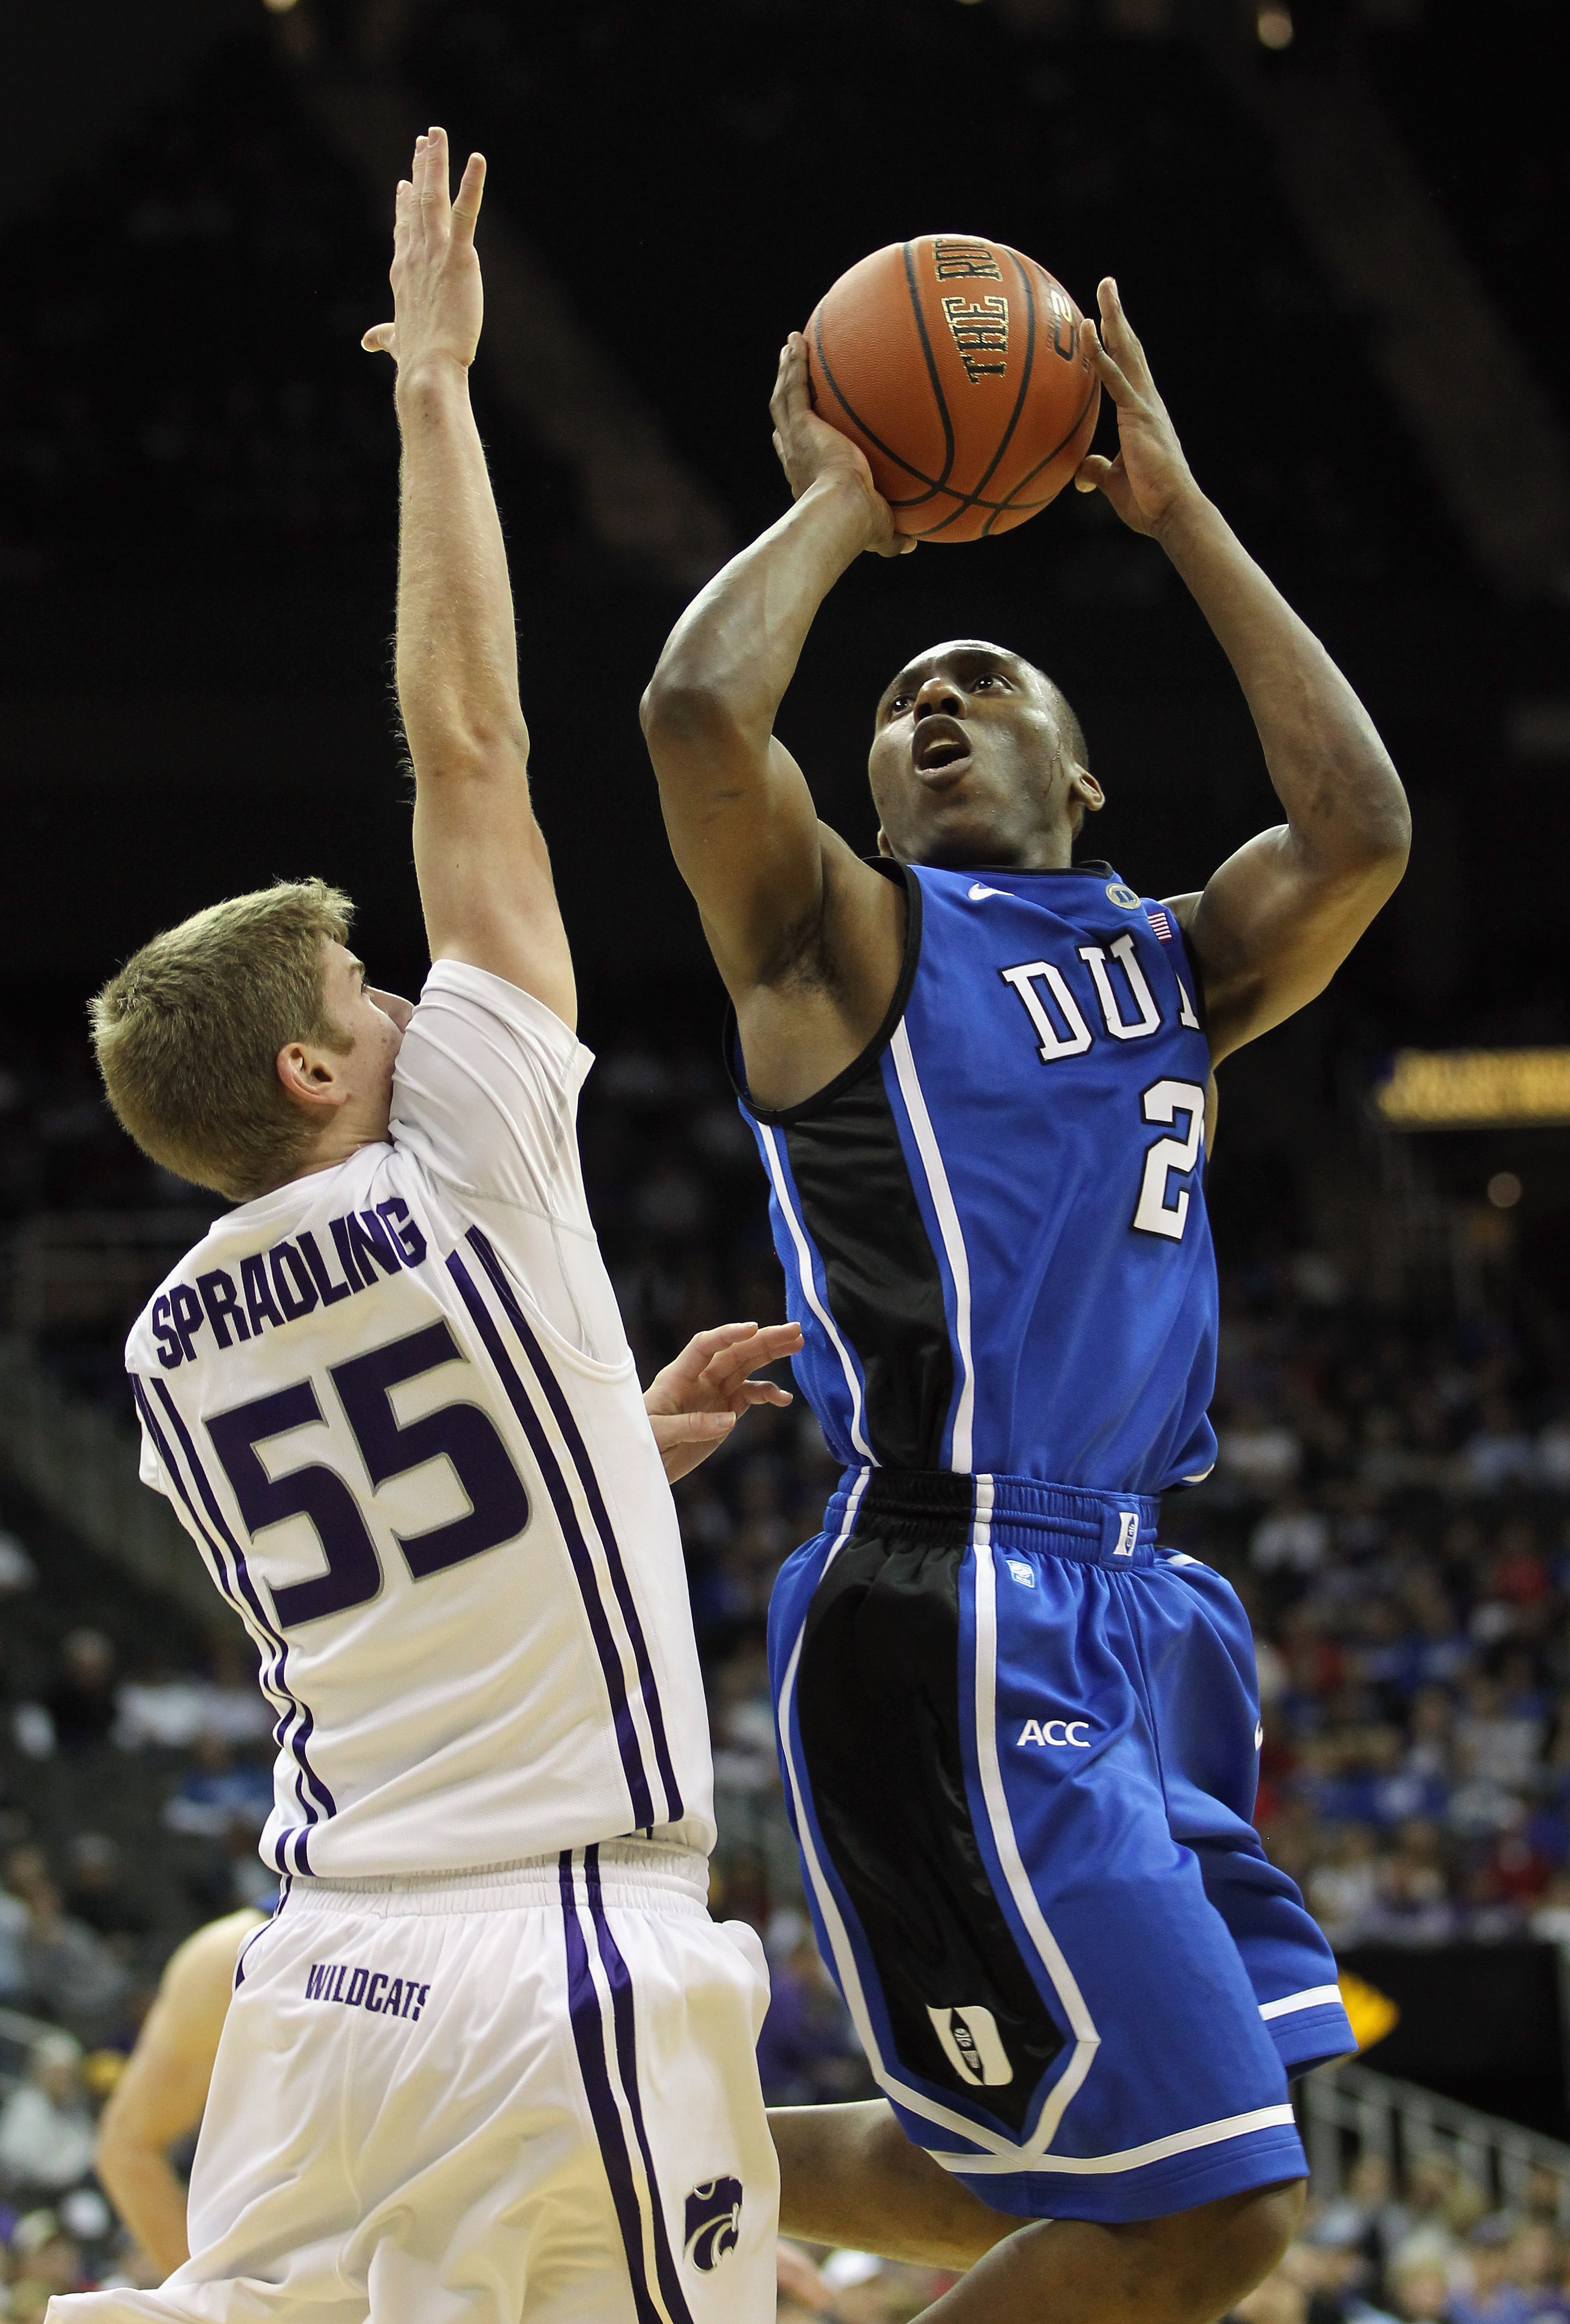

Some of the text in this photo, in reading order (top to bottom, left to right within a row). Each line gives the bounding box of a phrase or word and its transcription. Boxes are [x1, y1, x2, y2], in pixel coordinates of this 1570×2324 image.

[941, 295, 1009, 384] THE
[998, 933, 1202, 1064] DU
[1131, 1076, 1206, 1242] 2
[152, 1197, 427, 1370] SPRADLING
[201, 1316, 533, 1632] 55
[1017, 1719, 1091, 1748] ACC
